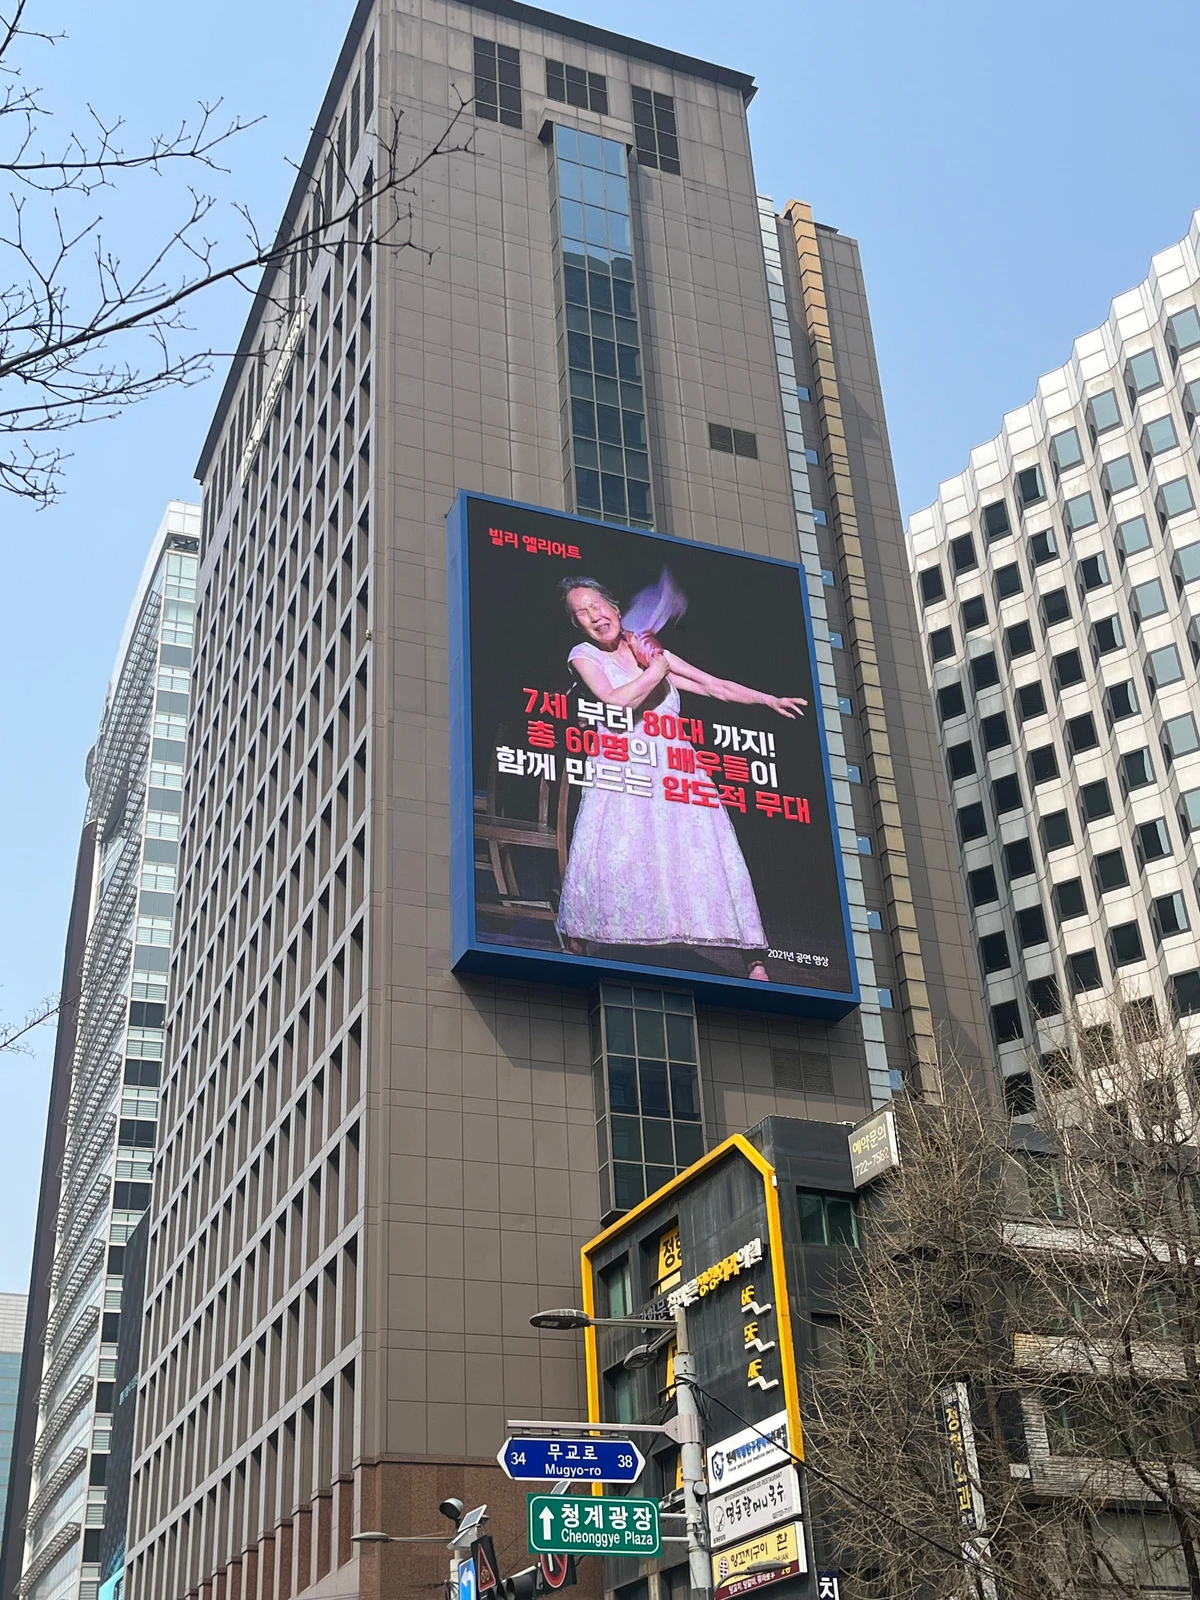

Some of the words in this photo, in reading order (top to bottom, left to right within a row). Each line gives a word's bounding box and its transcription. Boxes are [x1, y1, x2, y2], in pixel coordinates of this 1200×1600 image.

[489, 527, 518, 549] 빌리
[522, 535, 582, 559] 엘리어트
[522, 687, 568, 720] 7세
[577, 698, 635, 732] 부터
[642, 709, 705, 745] 80대
[712, 723, 776, 758] 까지!
[527, 720, 556, 749] 총
[565, 726, 658, 767] 60명의
[666, 746, 779, 789] 배우들이
[496, 745, 557, 782] 함께
[565, 757, 653, 798] 만드는
[662, 775, 747, 814] 압도적
[755, 790, 811, 824] 무대
[767, 948, 794, 962] 2021년
[796, 952, 812, 965] 공연
[812, 955, 829, 967] 영상
[852, 1123, 887, 1155] 예약문의
[510, 1452, 527, 1465] 34
[548, 1444, 598, 1461] 무교로
[617, 1455, 633, 1468] 38
[545, 1464, 602, 1477] Mugyo-ro
[560, 1504, 652, 1531] 청계광장
[561, 1528, 620, 1547] Cheonggye
[624, 1531, 653, 1545] Plaza
[730, 1541, 768, 1568] 양꼬치구이
[819, 1577, 840, 1600] 치
